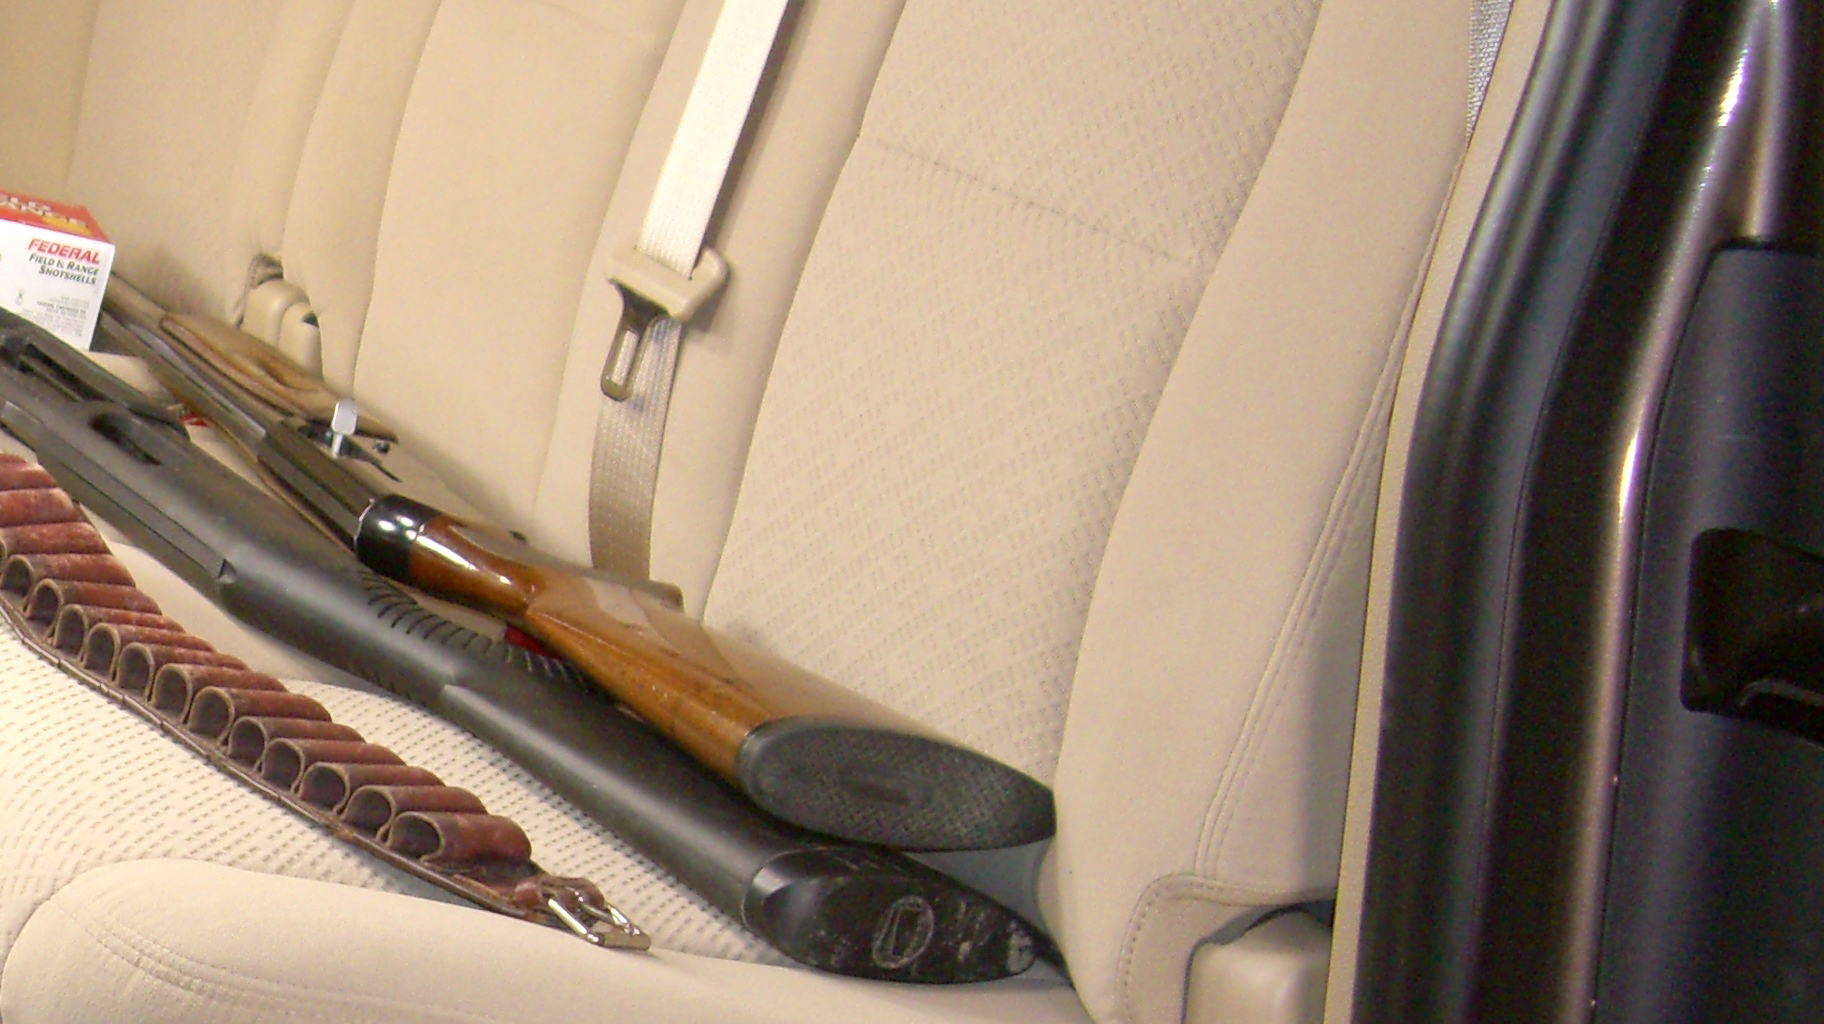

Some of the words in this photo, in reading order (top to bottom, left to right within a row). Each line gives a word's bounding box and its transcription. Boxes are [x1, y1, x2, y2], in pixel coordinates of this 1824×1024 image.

[28, 238, 100, 264] FEDERAL
[29, 253, 55, 266] FIELD
[66, 261, 99, 275] RANGE
[38, 265, 96, 285] SHOTSHELLS
